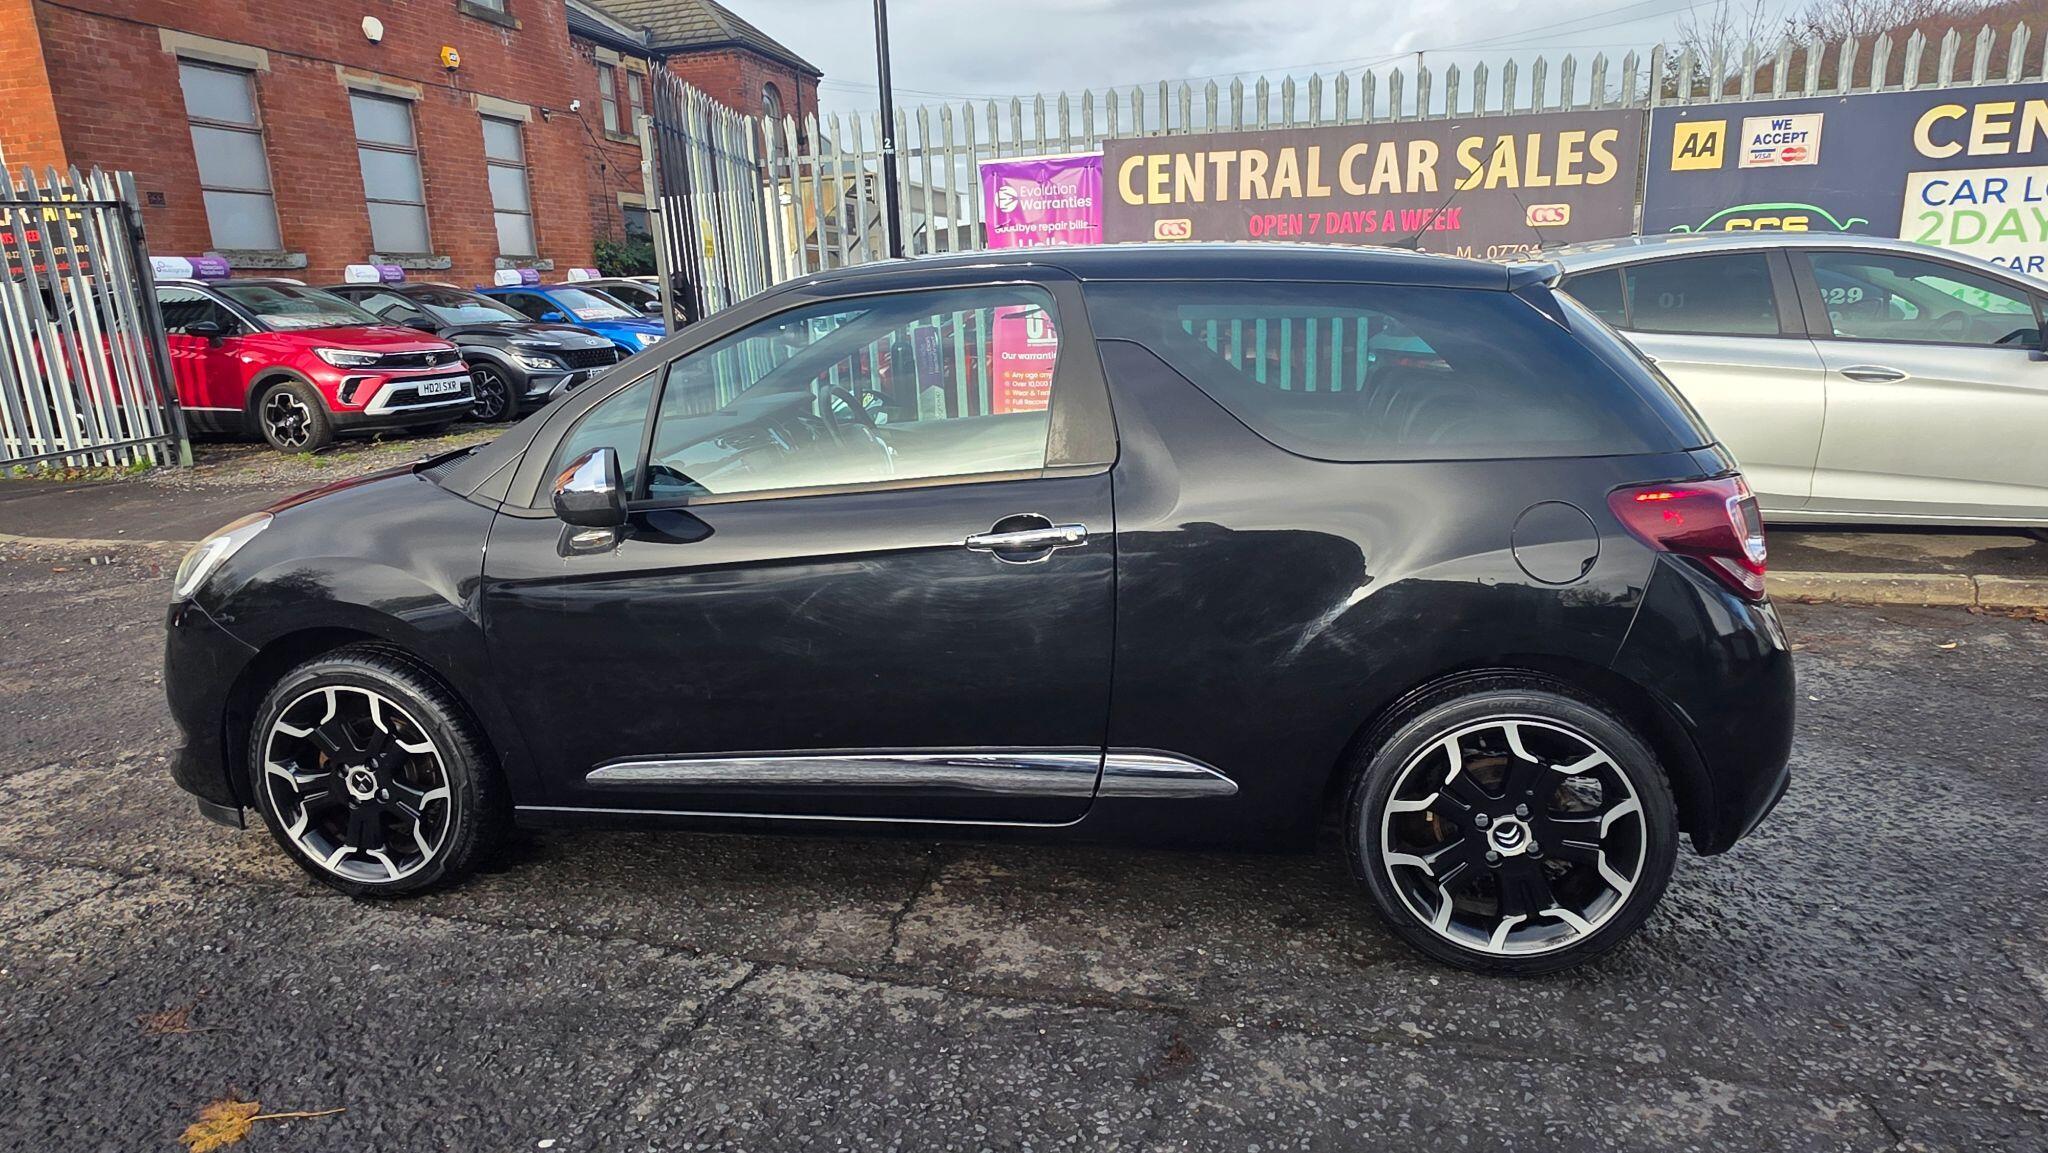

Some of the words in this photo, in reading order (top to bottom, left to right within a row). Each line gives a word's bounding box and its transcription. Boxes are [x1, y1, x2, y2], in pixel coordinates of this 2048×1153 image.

[1771, 119, 1793, 131] WE
[884, 137, 892, 149] 2
[1678, 131, 1718, 159] AA
[1753, 131, 1808, 146] ACCEPT
[1753, 152, 1772, 160] VISA
[1118, 146, 1331, 206] CENTRAL
[1338, 140, 1439, 196] CAR
[1454, 129, 1619, 191] SALES
[1020, 184, 1077, 198] Evolution
[1921, 177, 2009, 207] CAR
[2023, 175, 2048, 203] L
[1020, 197, 1092, 211] Warranties
[1039, 221, 1067, 233] repair
[1250, 213, 1303, 238] OPEN
[1308, 213, 1320, 235] 7
[1325, 210, 1377, 235] DAYS
[1381, 209, 1396, 233] A
[1401, 206, 1463, 232] WEEK
[1001, 352, 1016, 360] Our
